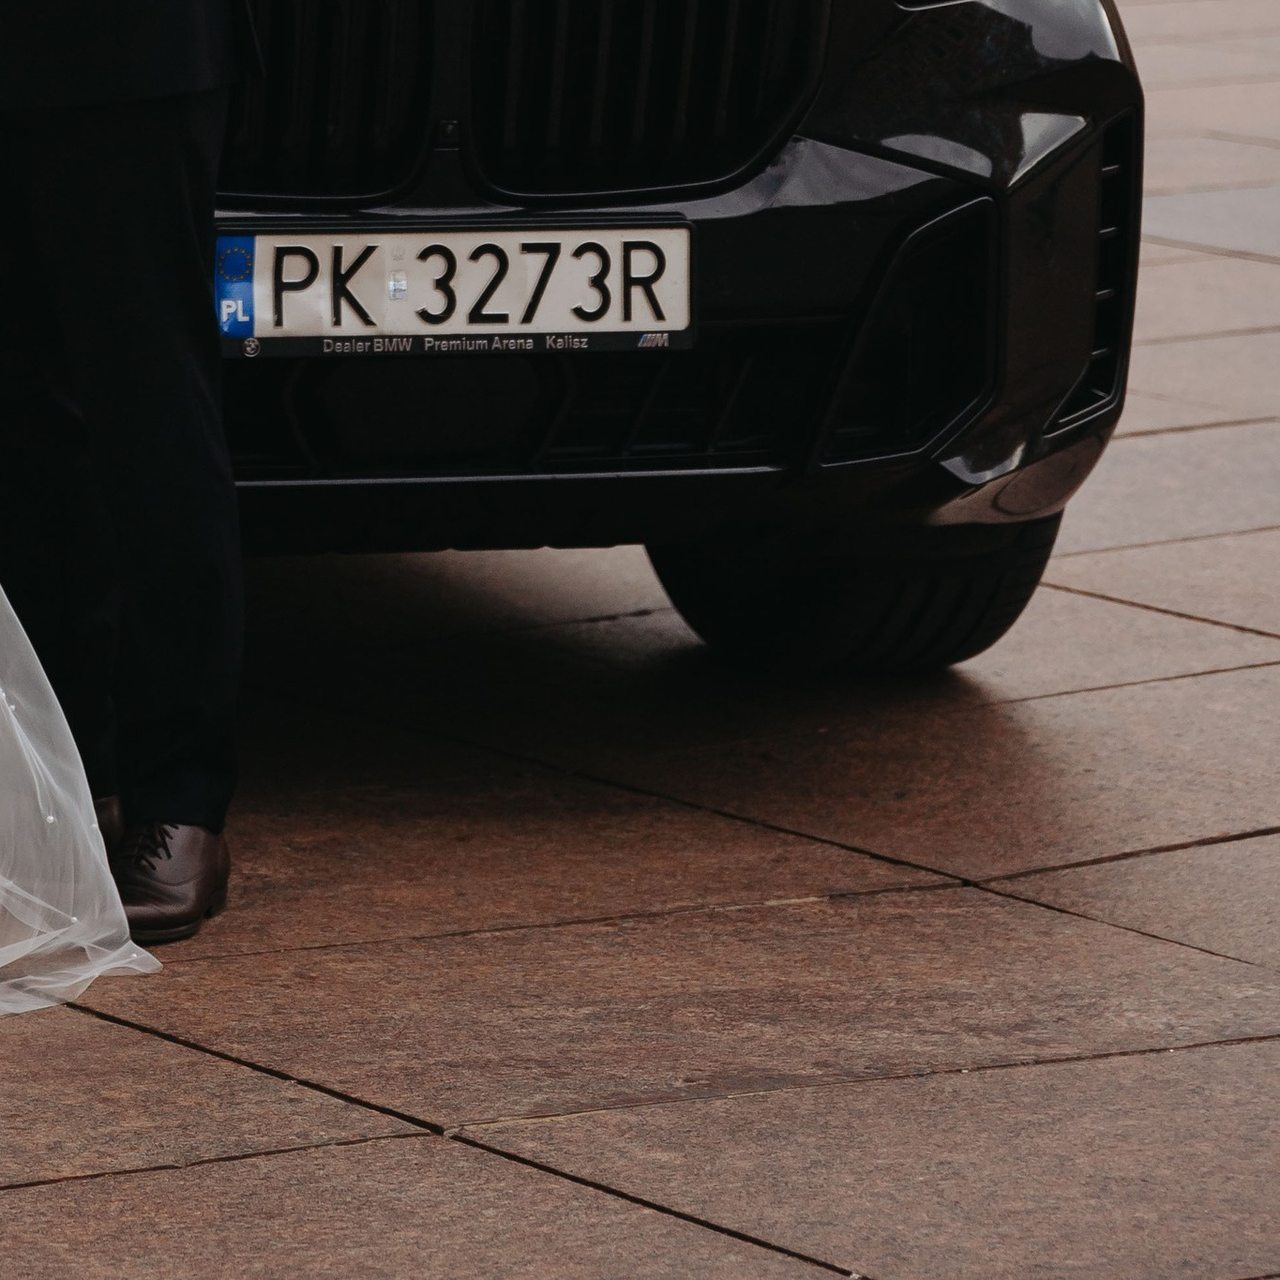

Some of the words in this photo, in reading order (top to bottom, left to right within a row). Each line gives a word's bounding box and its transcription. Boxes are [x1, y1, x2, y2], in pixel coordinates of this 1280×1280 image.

[272, 243, 381, 328] PK
[414, 239, 667, 326] 3273R
[220, 299, 250, 324] PL
[322, 338, 371, 353] Dealer
[373, 337, 413, 353] BMW
[424, 337, 489, 352] Premium
[491, 336, 534, 351] Arena
[545, 334, 589, 350] Kalisz
